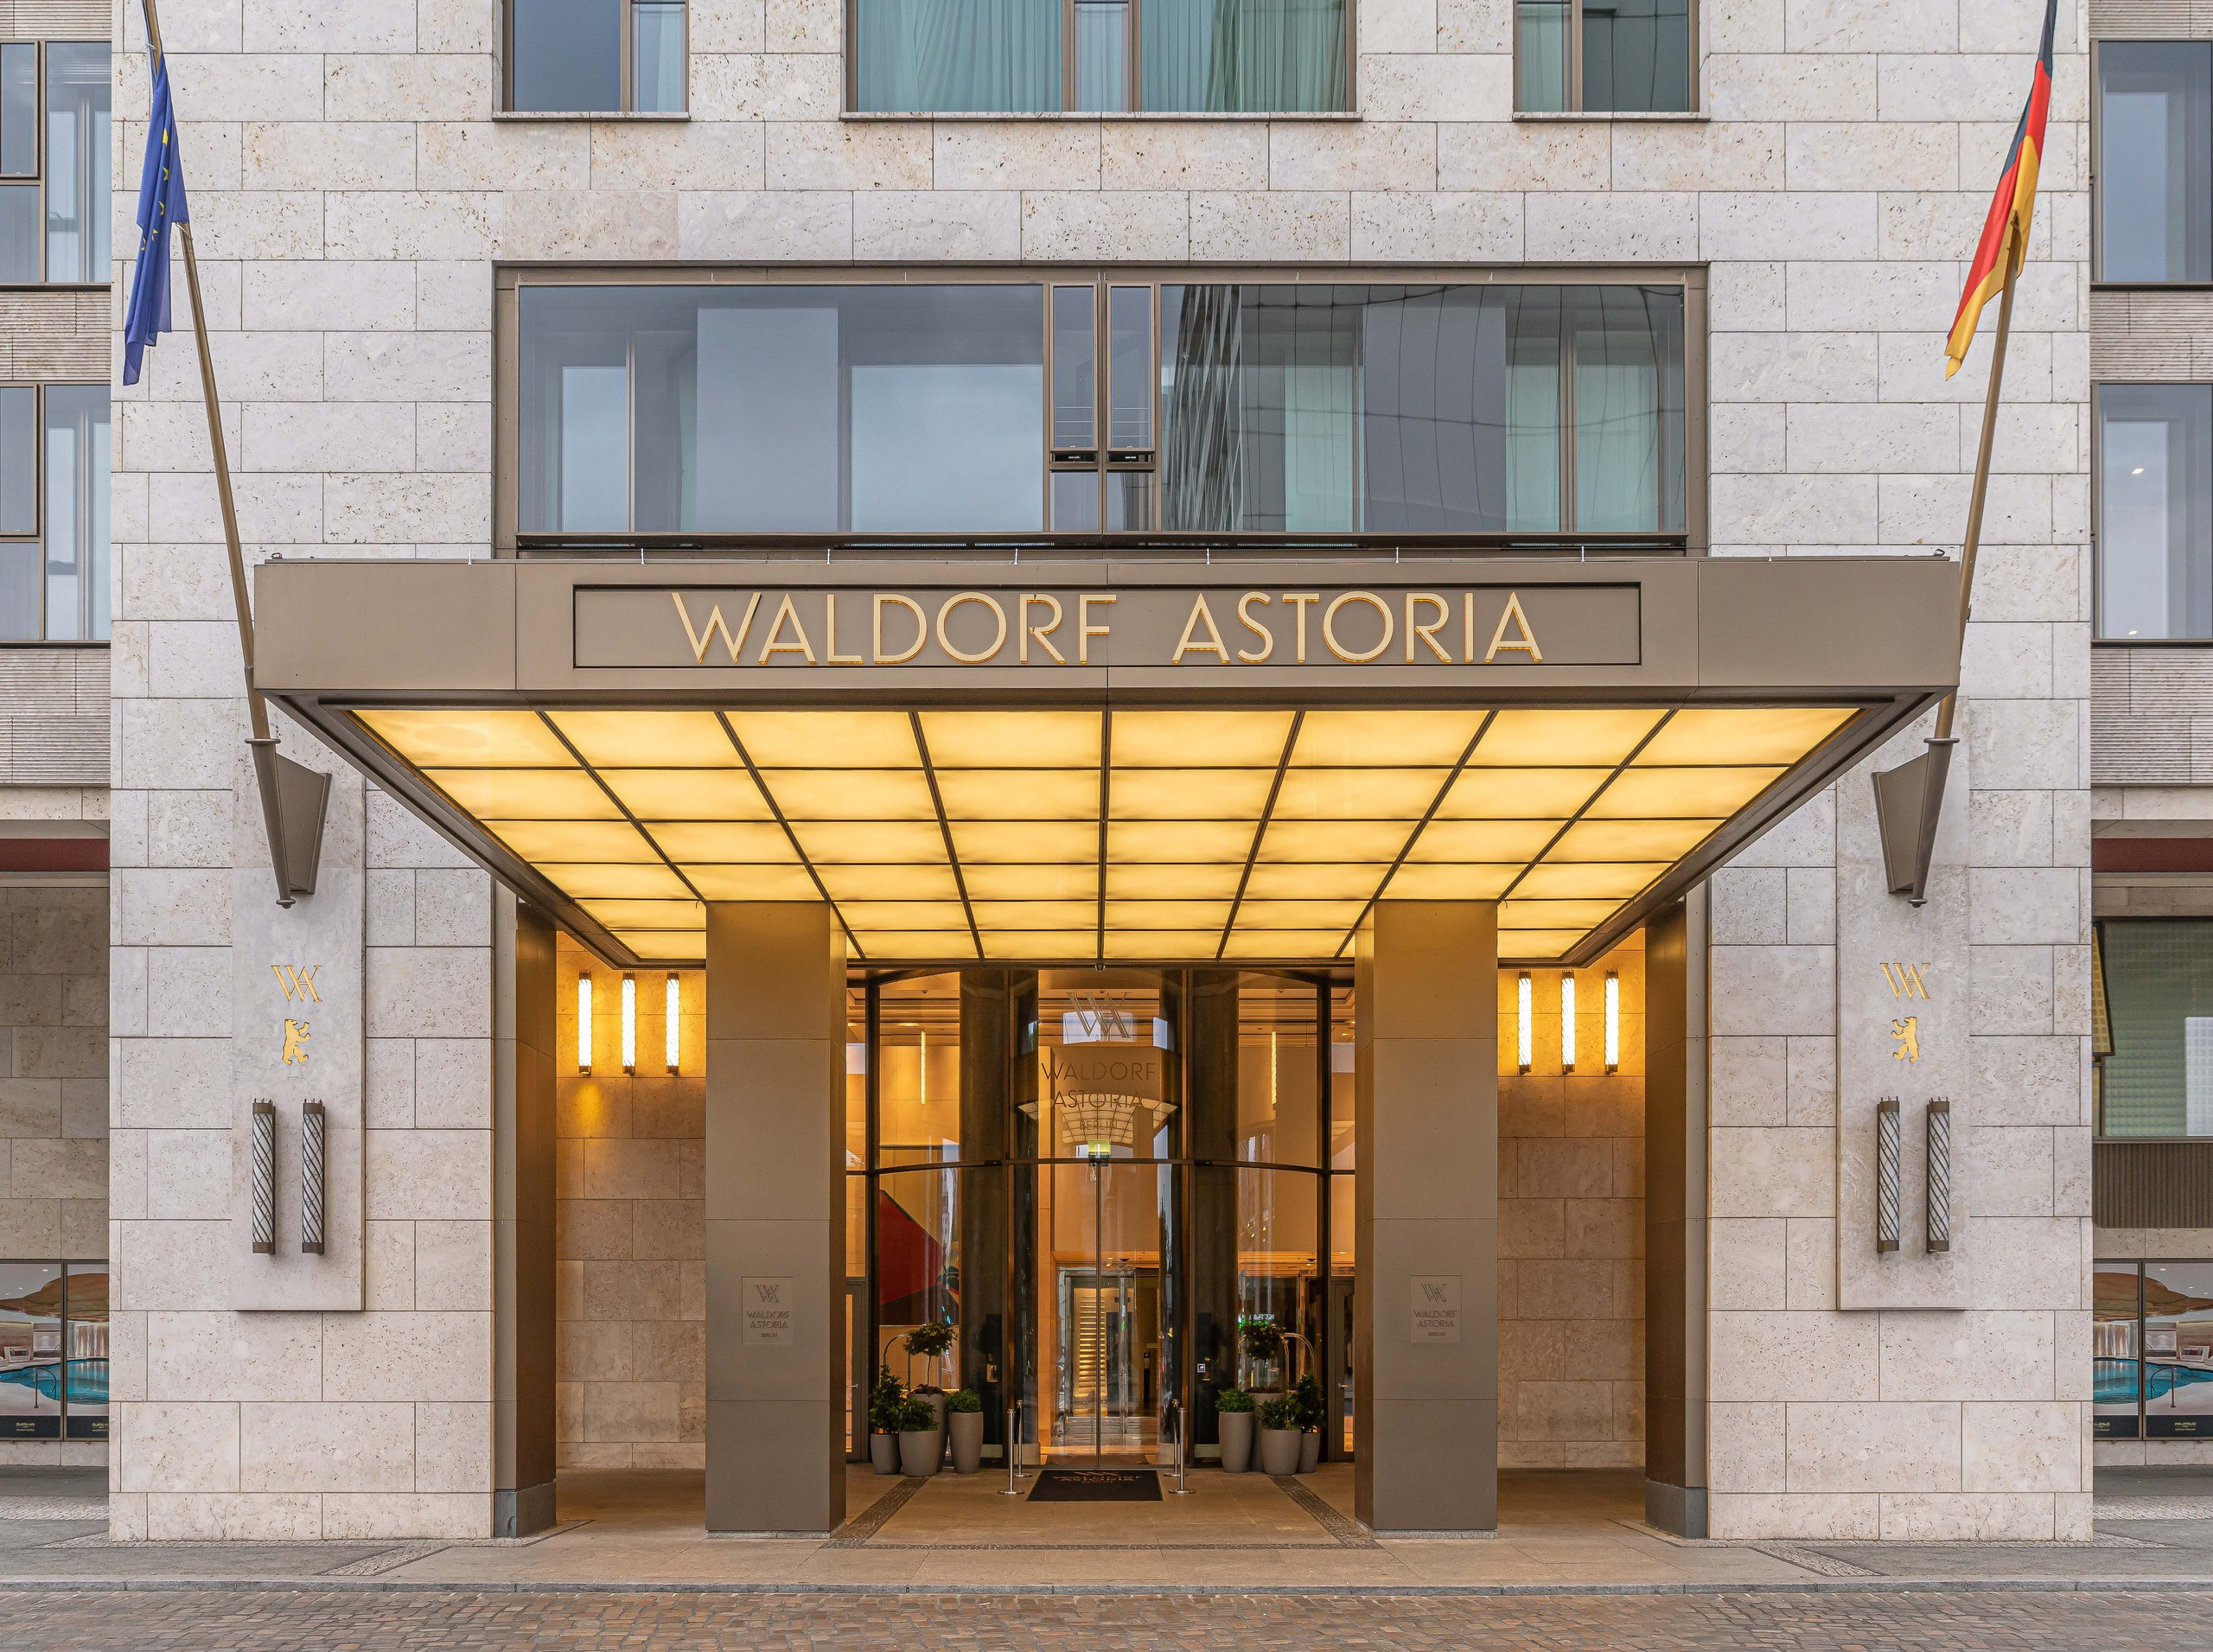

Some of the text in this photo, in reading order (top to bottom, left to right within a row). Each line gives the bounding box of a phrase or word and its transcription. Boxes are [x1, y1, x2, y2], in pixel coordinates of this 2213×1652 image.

[671, 590, 1544, 665] WALDORF ASTORIA
[1041, 1062, 1157, 1081] WALDORF
[1053, 1089, 1145, 1108] ASTORIA
[1079, 1119, 1118, 1131] BERLIN
[746, 1310, 791, 1319] WALDORF
[1413, 1310, 1458, 1318] WALDORF
[749, 1320, 788, 1329] ASTORIA
[1418, 1319, 1455, 1328] ASTORIA
